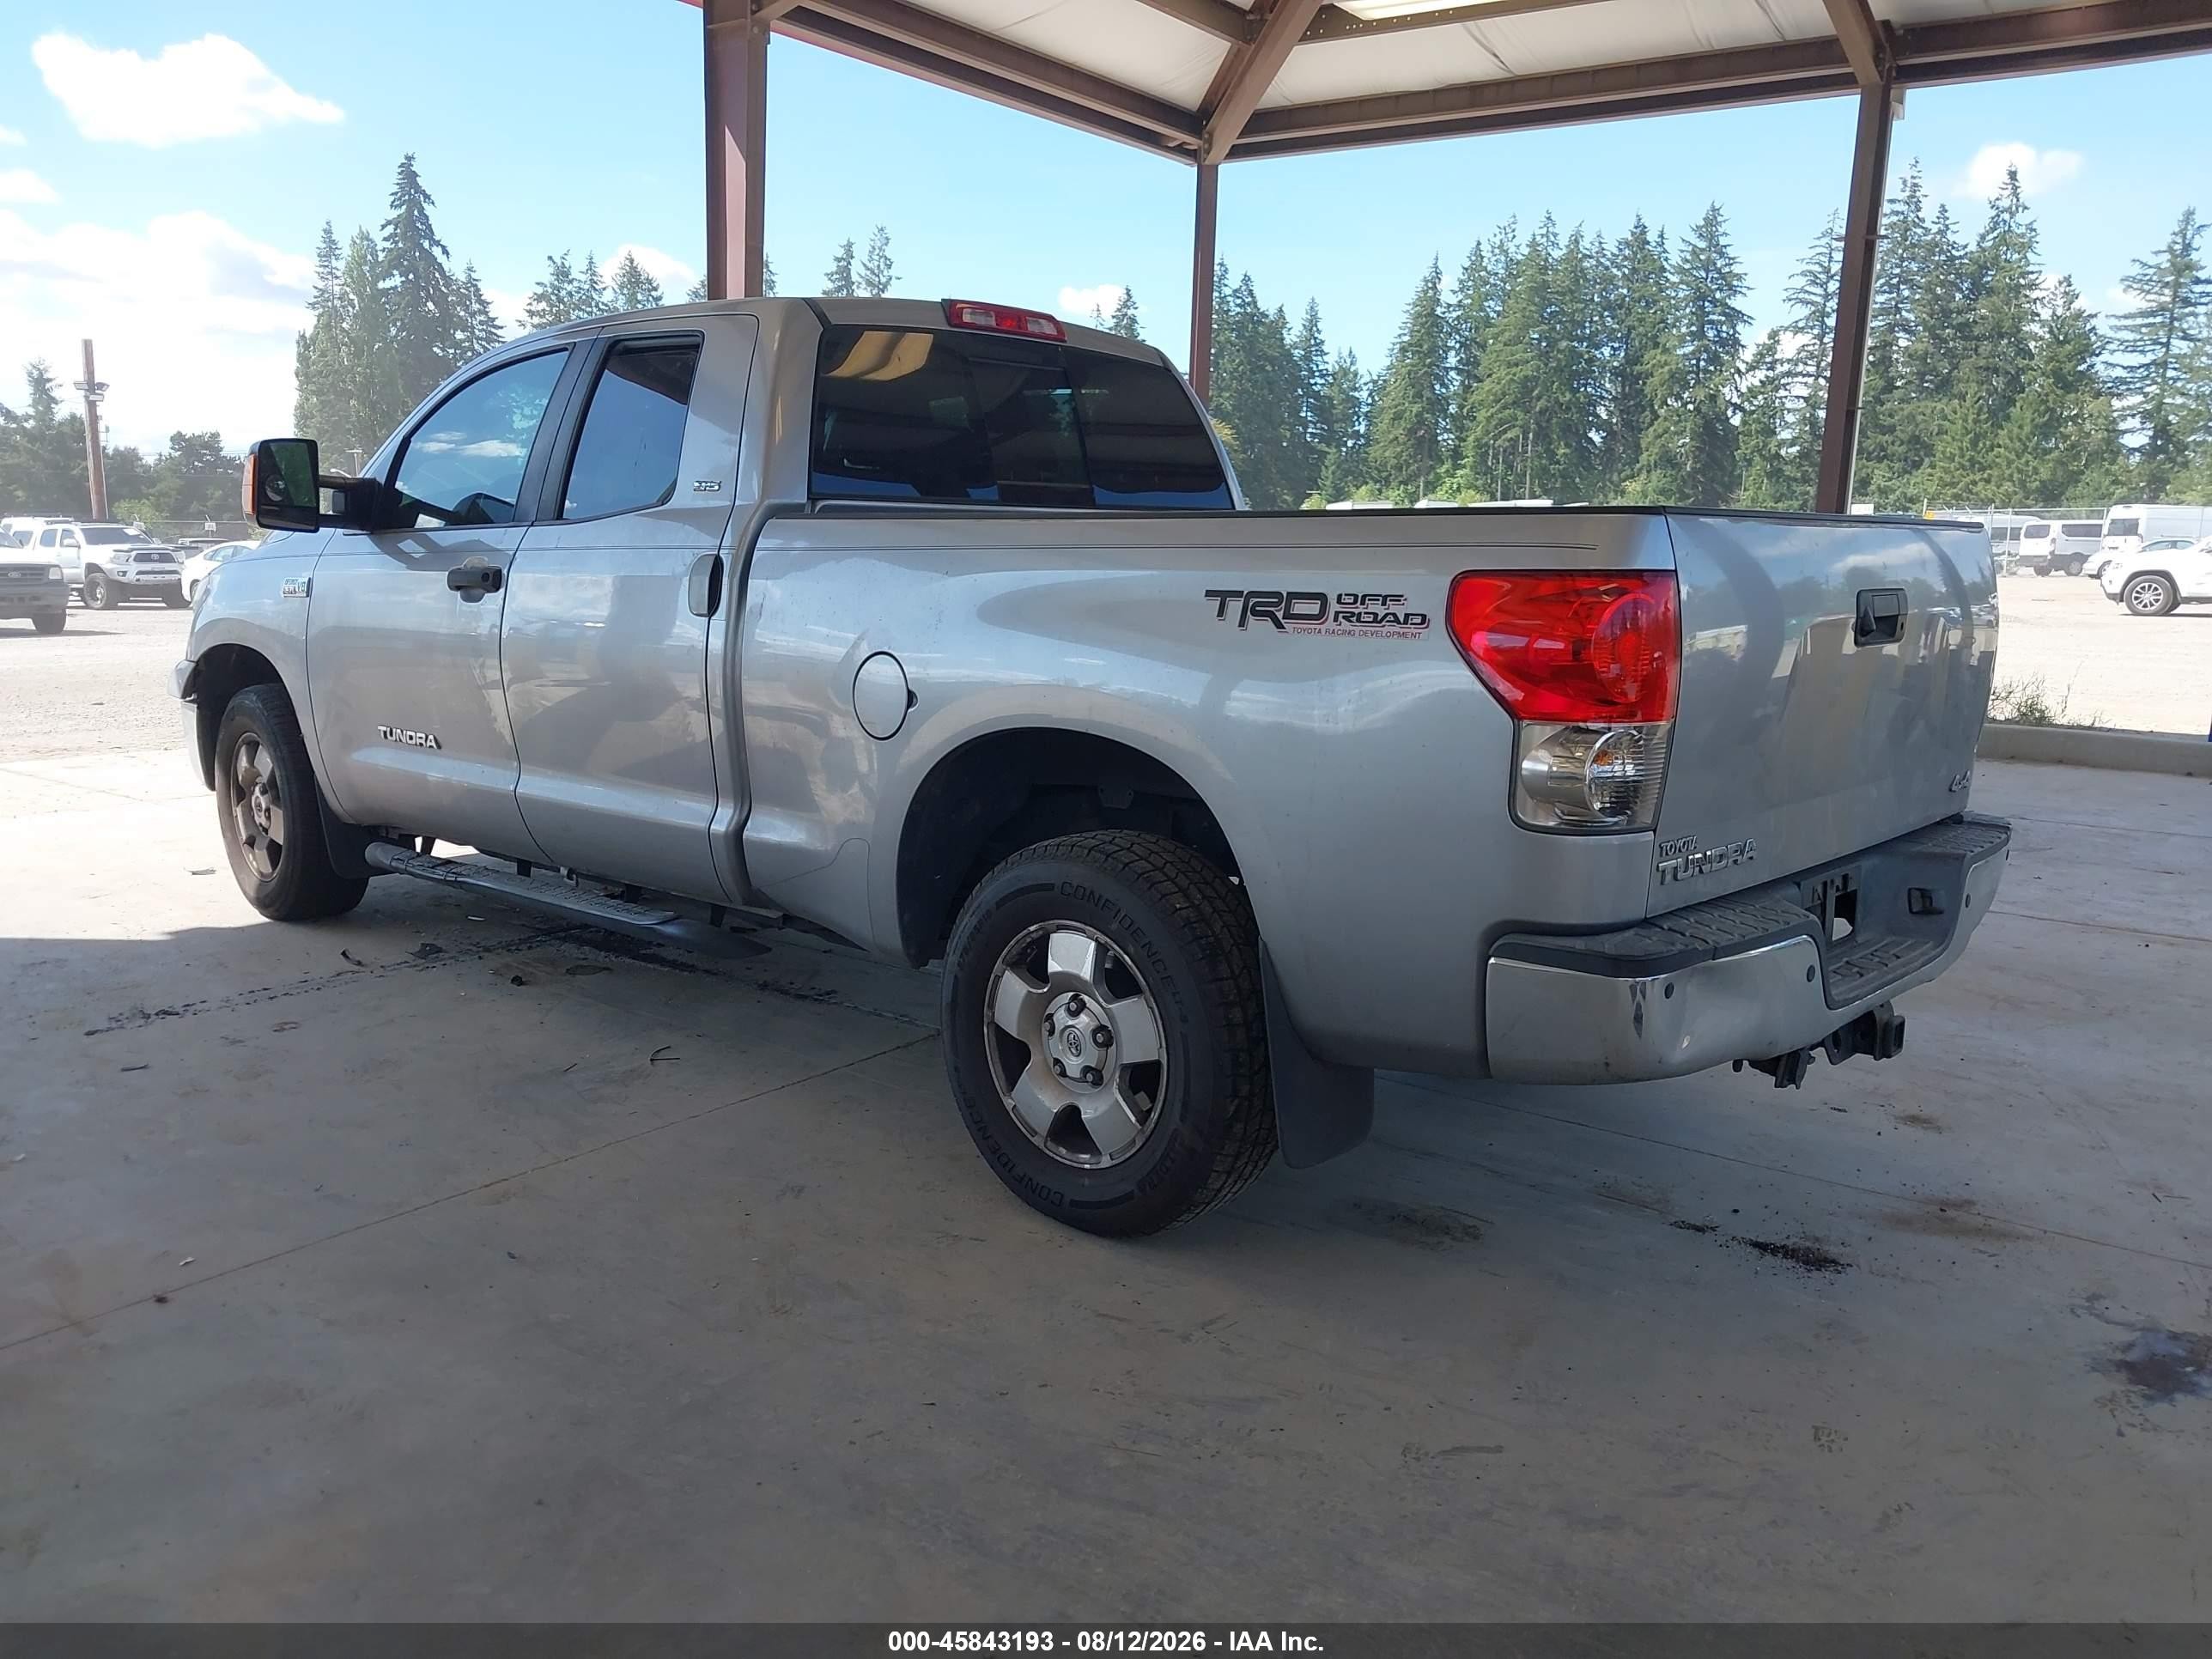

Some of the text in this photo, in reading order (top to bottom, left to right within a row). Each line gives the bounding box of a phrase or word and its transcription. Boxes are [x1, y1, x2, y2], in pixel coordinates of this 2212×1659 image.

[1204, 589, 1330, 633] TRD
[1336, 592, 1407, 610] OFF
[1333, 611, 1431, 629] ROAD
[1291, 626, 1423, 641] TOYOTA RACING DEVELOPMENT
[377, 725, 441, 750] TUNDRA
[1658, 836, 1698, 857] TOYOTA
[1657, 838, 1758, 885] TUNDRA
[1060, 881, 1176, 989] CONFIDENCE
